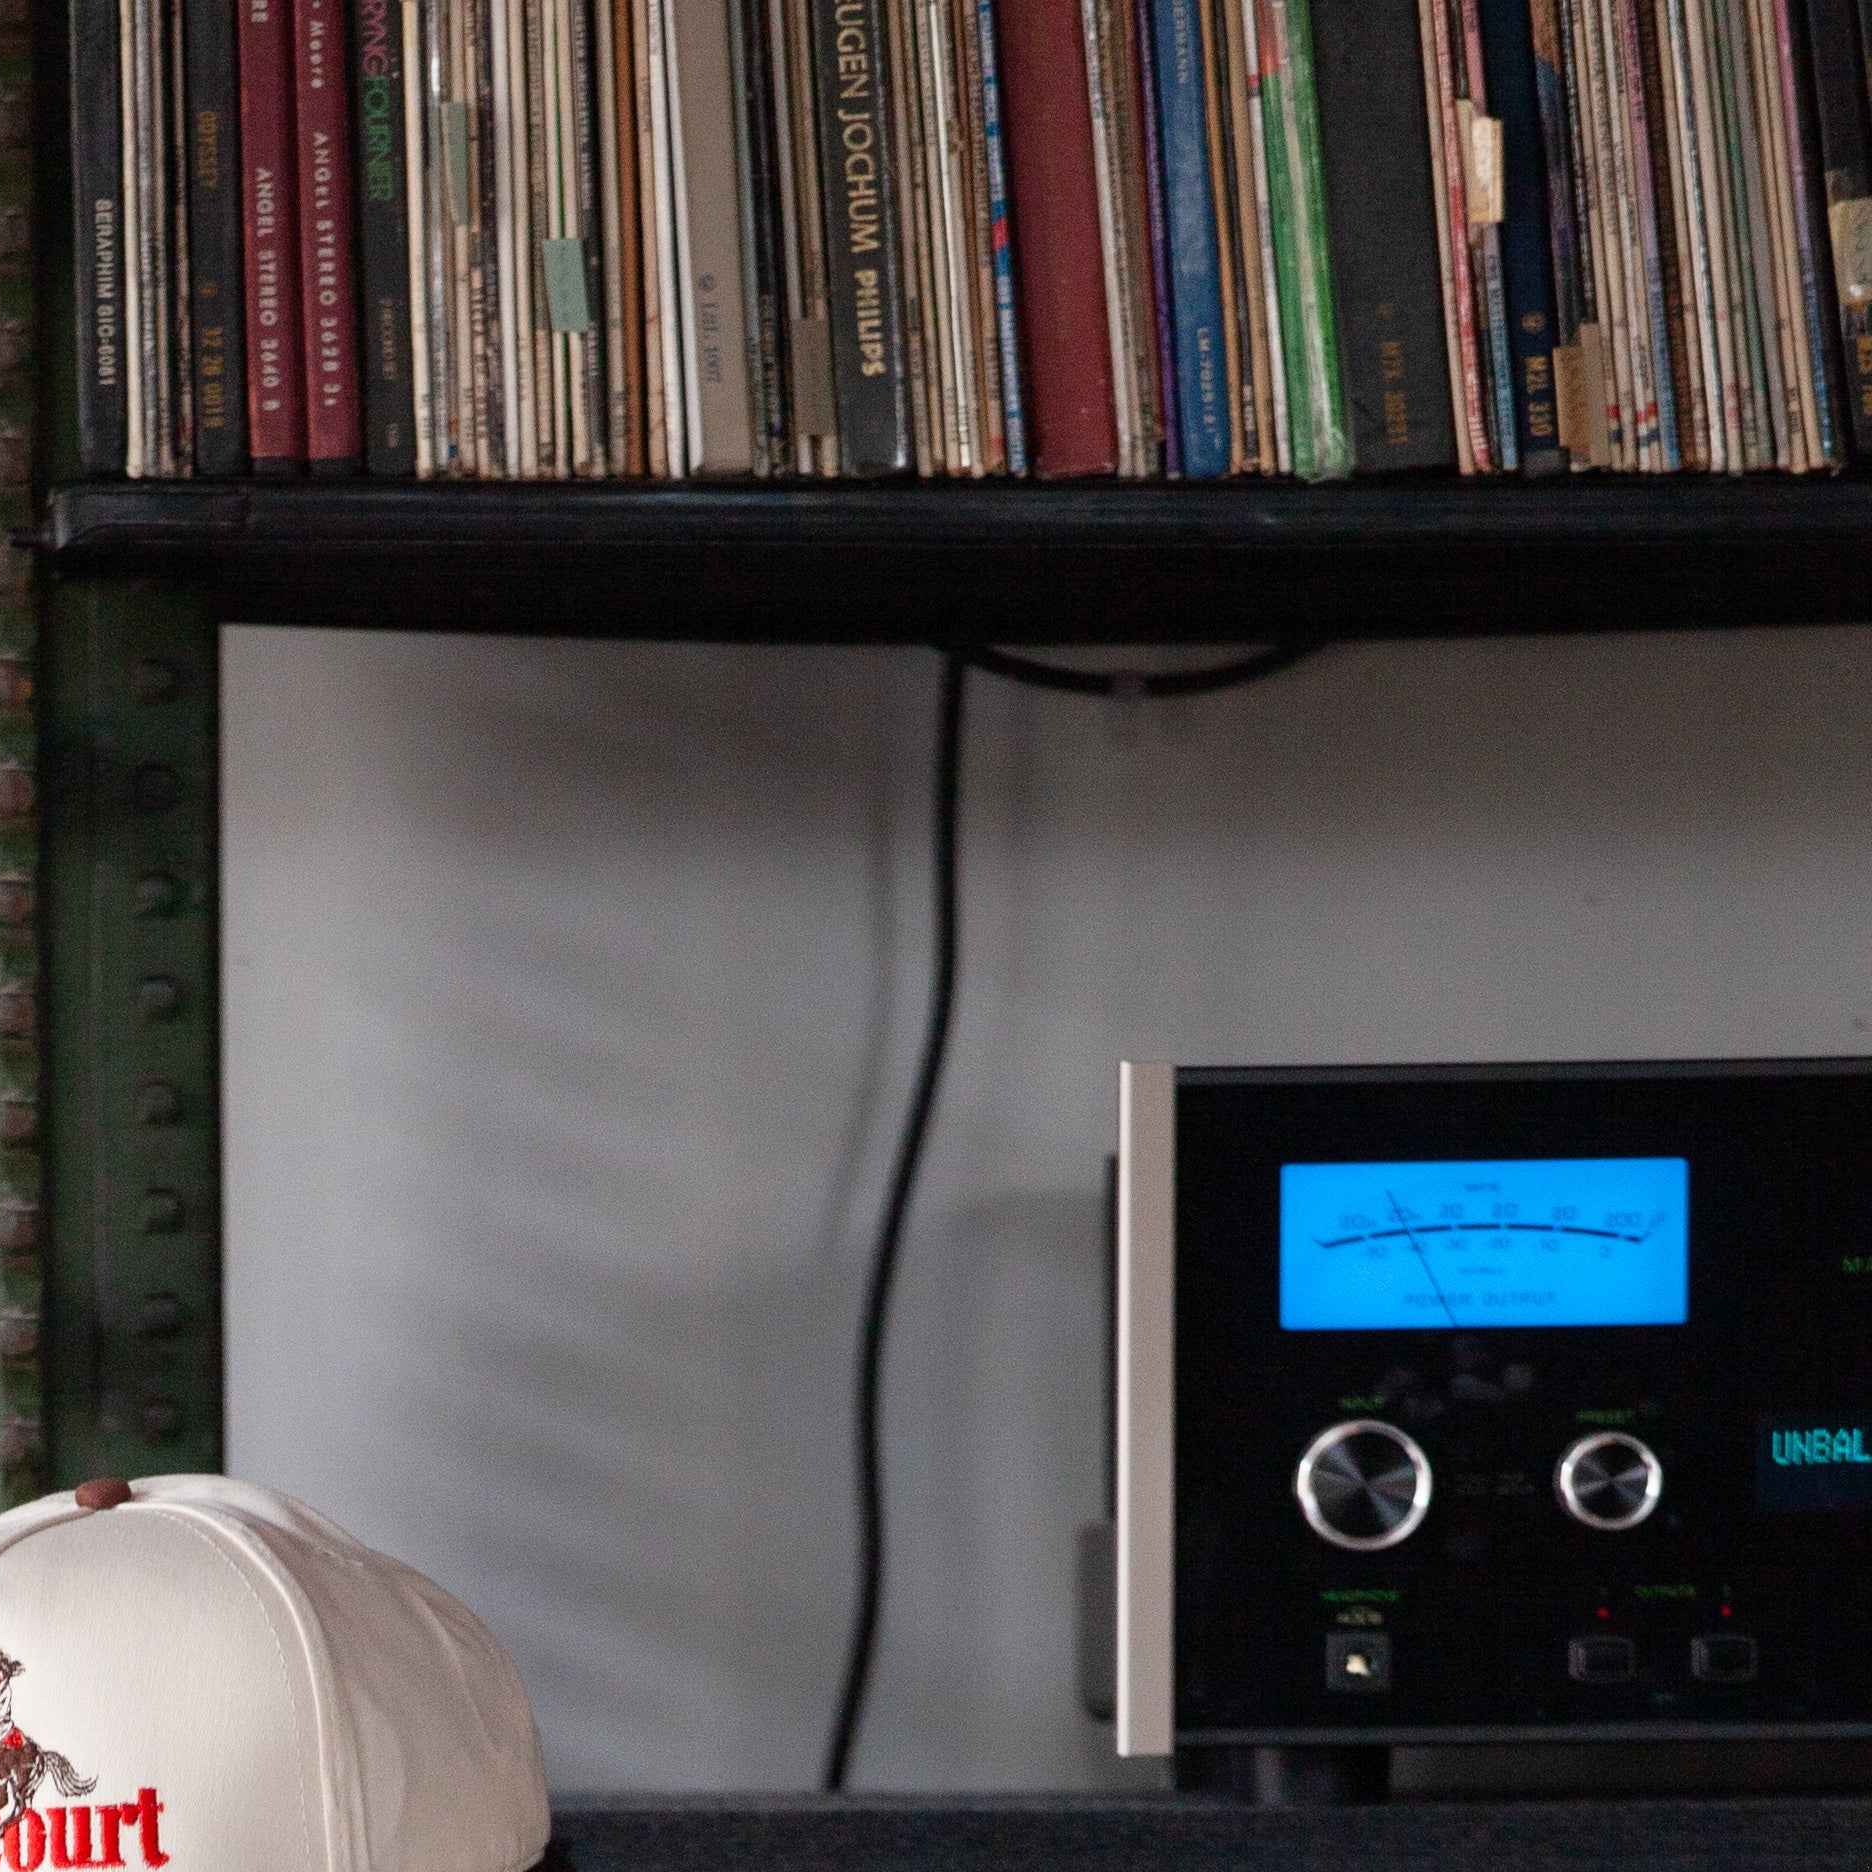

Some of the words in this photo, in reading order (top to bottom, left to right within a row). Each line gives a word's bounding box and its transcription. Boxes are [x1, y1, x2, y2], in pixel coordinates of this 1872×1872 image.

[309, 20, 326, 91] Moore
[196, 110, 221, 190] ODYSSEY
[312, 131, 336, 210] ANGEL
[837, 108, 879, 253] JOCHUM
[254, 167, 276, 238] ANGEL
[94, 199, 116, 299] SERAPHIM
[258, 249, 280, 327] STEREO
[316, 219, 339, 307] STEREO
[320, 316, 342, 373] 3628
[853, 268, 887, 377] PHILIPS
[261, 338, 281, 388] 3640
[1771, 1426, 1872, 1467] UNBAL
